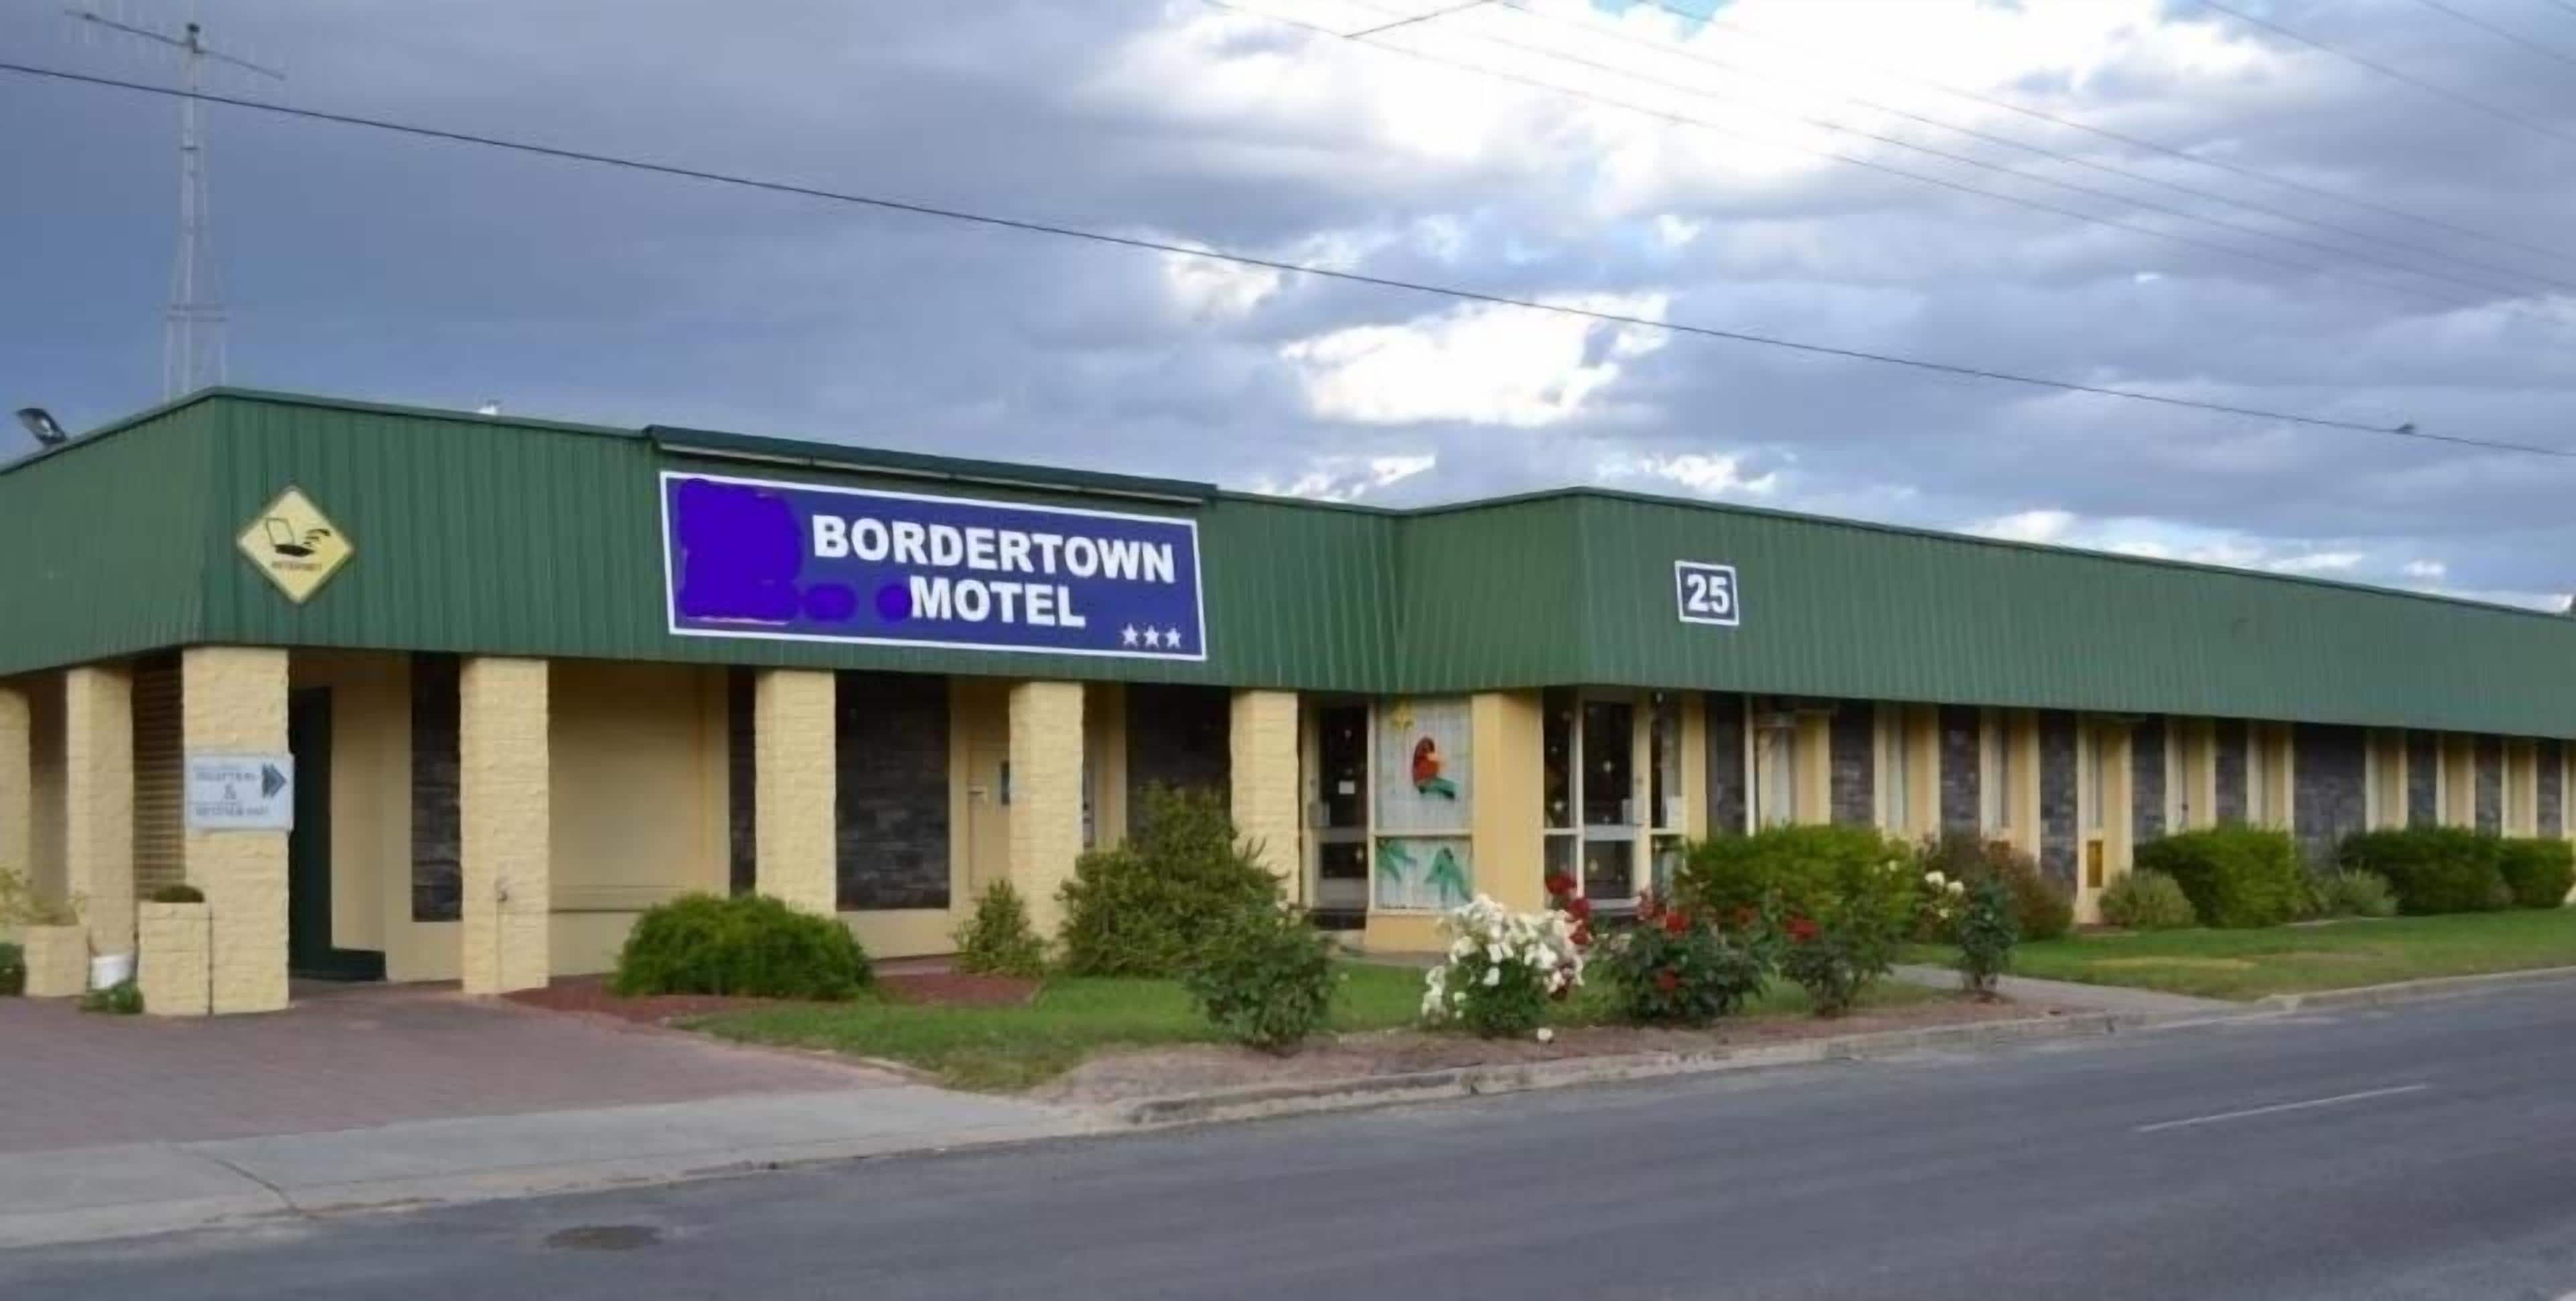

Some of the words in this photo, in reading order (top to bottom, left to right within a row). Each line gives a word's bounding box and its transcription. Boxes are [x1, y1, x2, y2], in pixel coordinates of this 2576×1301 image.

[812, 515, 1175, 583] BORDERTOWN
[910, 576, 1086, 627] MOTEL
[1687, 574, 1730, 614] 25
